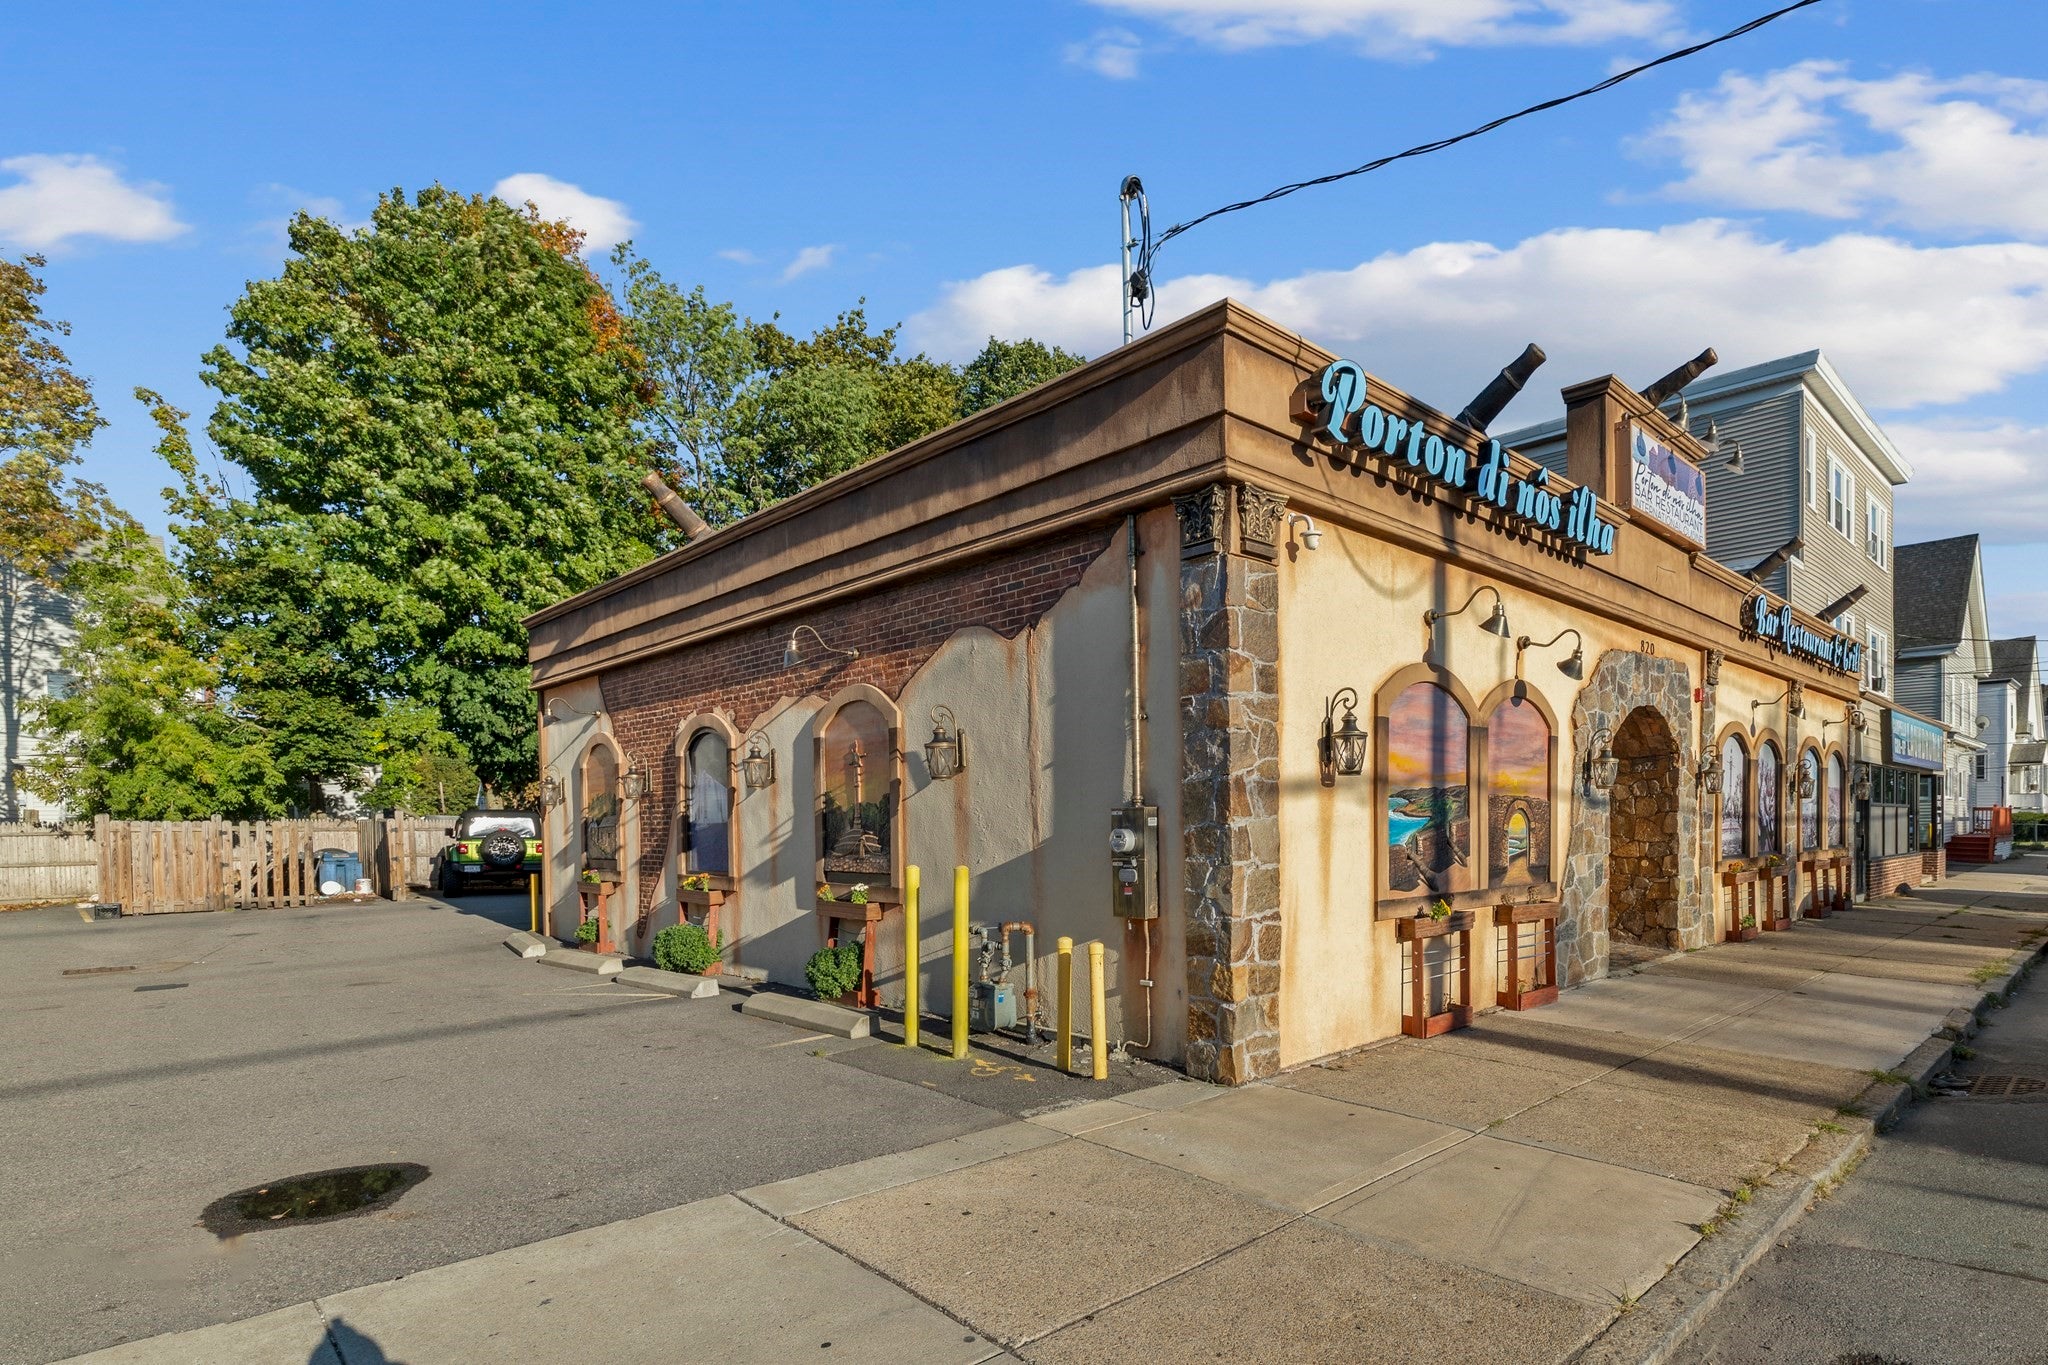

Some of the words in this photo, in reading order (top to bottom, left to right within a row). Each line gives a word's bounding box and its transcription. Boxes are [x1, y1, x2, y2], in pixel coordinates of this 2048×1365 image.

[1321, 359, 1466, 487] Porton
[1478, 439, 1509, 507] di
[1516, 467, 1561, 530] nôs
[1568, 485, 1614, 555] ilha
[1634, 483, 1653, 501] BAR
[1655, 496, 1704, 535] RESTAURANT
[1640, 639, 1655, 655] 820
[1755, 594, 1779, 637] Bar
[1780, 604, 1834, 661] Restaurant
